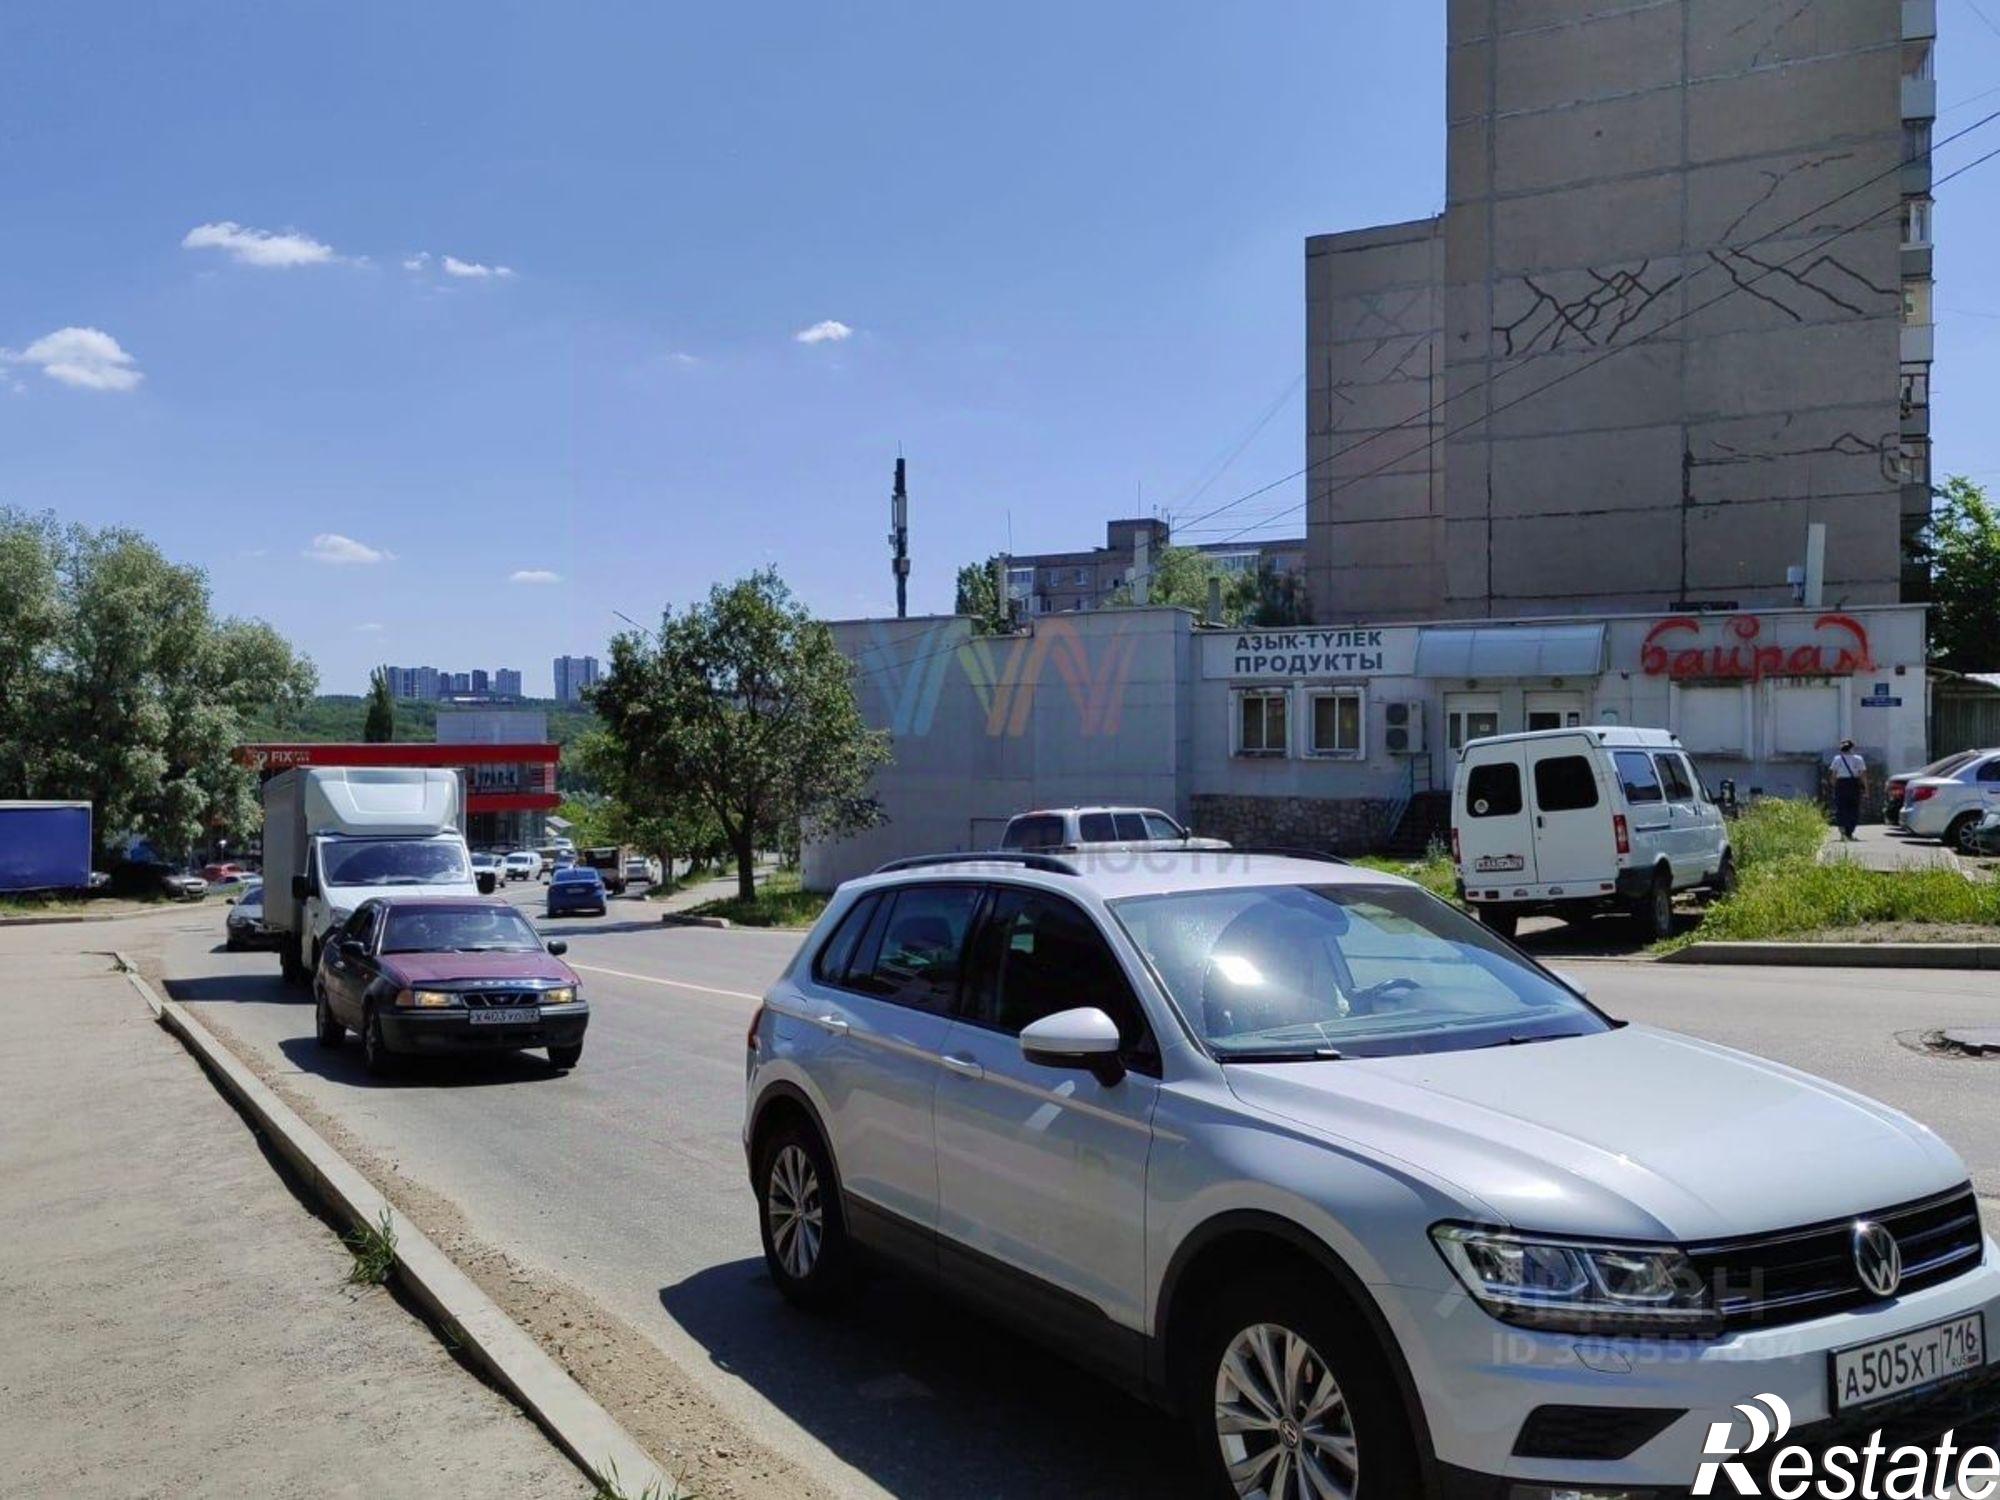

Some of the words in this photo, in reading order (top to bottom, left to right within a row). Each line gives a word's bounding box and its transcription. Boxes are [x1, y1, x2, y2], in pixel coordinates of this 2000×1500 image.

[1235, 652, 1383, 676] ПРОДУКТЫ
[1845, 1342, 1938, 1400] А505ХТ
[1943, 1321, 1976, 1359] 716
